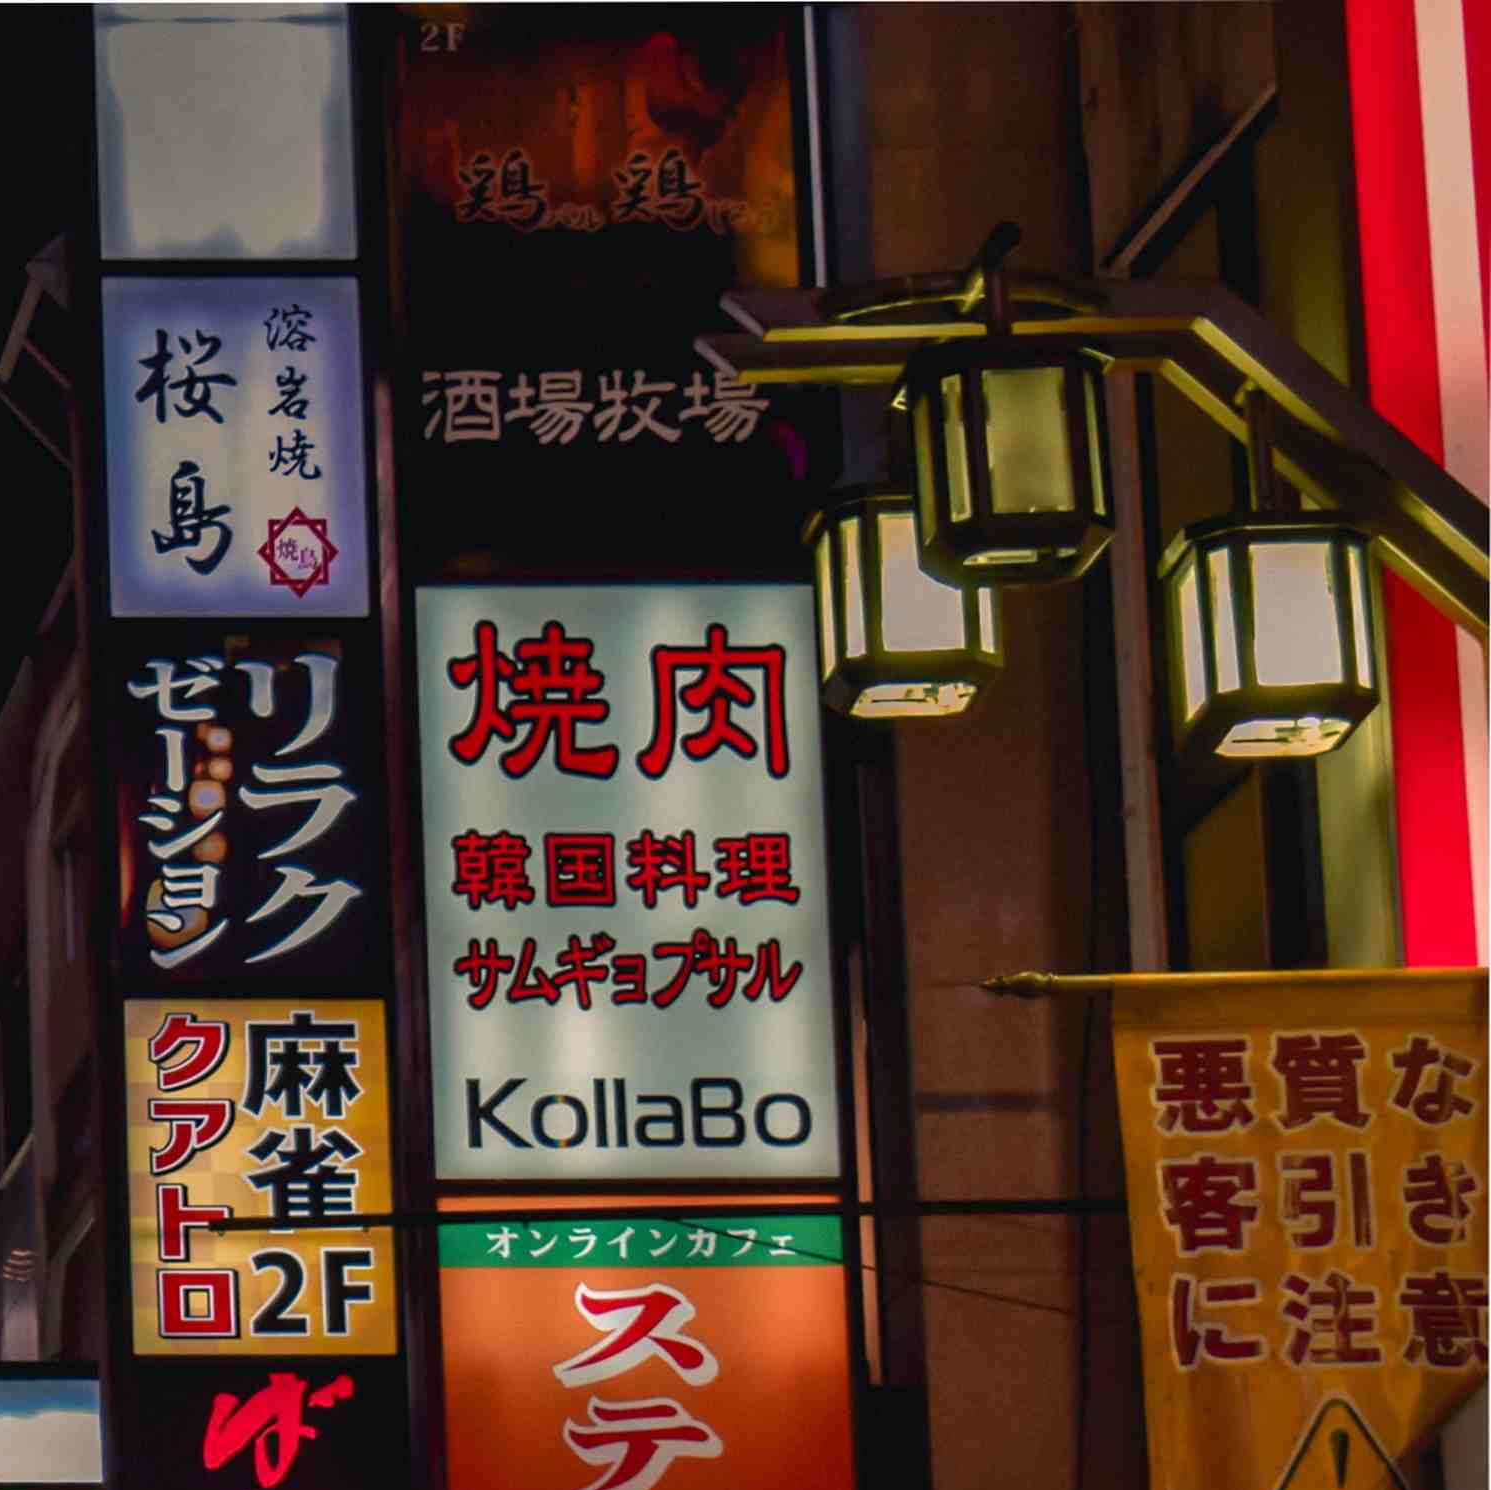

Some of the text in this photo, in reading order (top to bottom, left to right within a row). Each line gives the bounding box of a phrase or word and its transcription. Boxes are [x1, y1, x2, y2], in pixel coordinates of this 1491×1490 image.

[134, 328, 237, 576] 桜島
[449, 618, 792, 783] 焼肉
[237, 652, 363, 966] リラク
[451, 830, 802, 911] 韓国料理
[453, 928, 806, 1012] サムギョプサル
[241, 1012, 363, 1234] 麻雀
[465, 1076, 813, 1150] KollaBo
[1147, 1032, 1481, 1136] 悪質な
[147, 1012, 241, 1342] クアトロ
[1159, 1148, 1479, 1257] 客引き
[249, 1250, 375, 1335] 2F
[484, 1224, 797, 1259] オンラインカフェ
[1169, 1268, 1490, 1371] に注意
